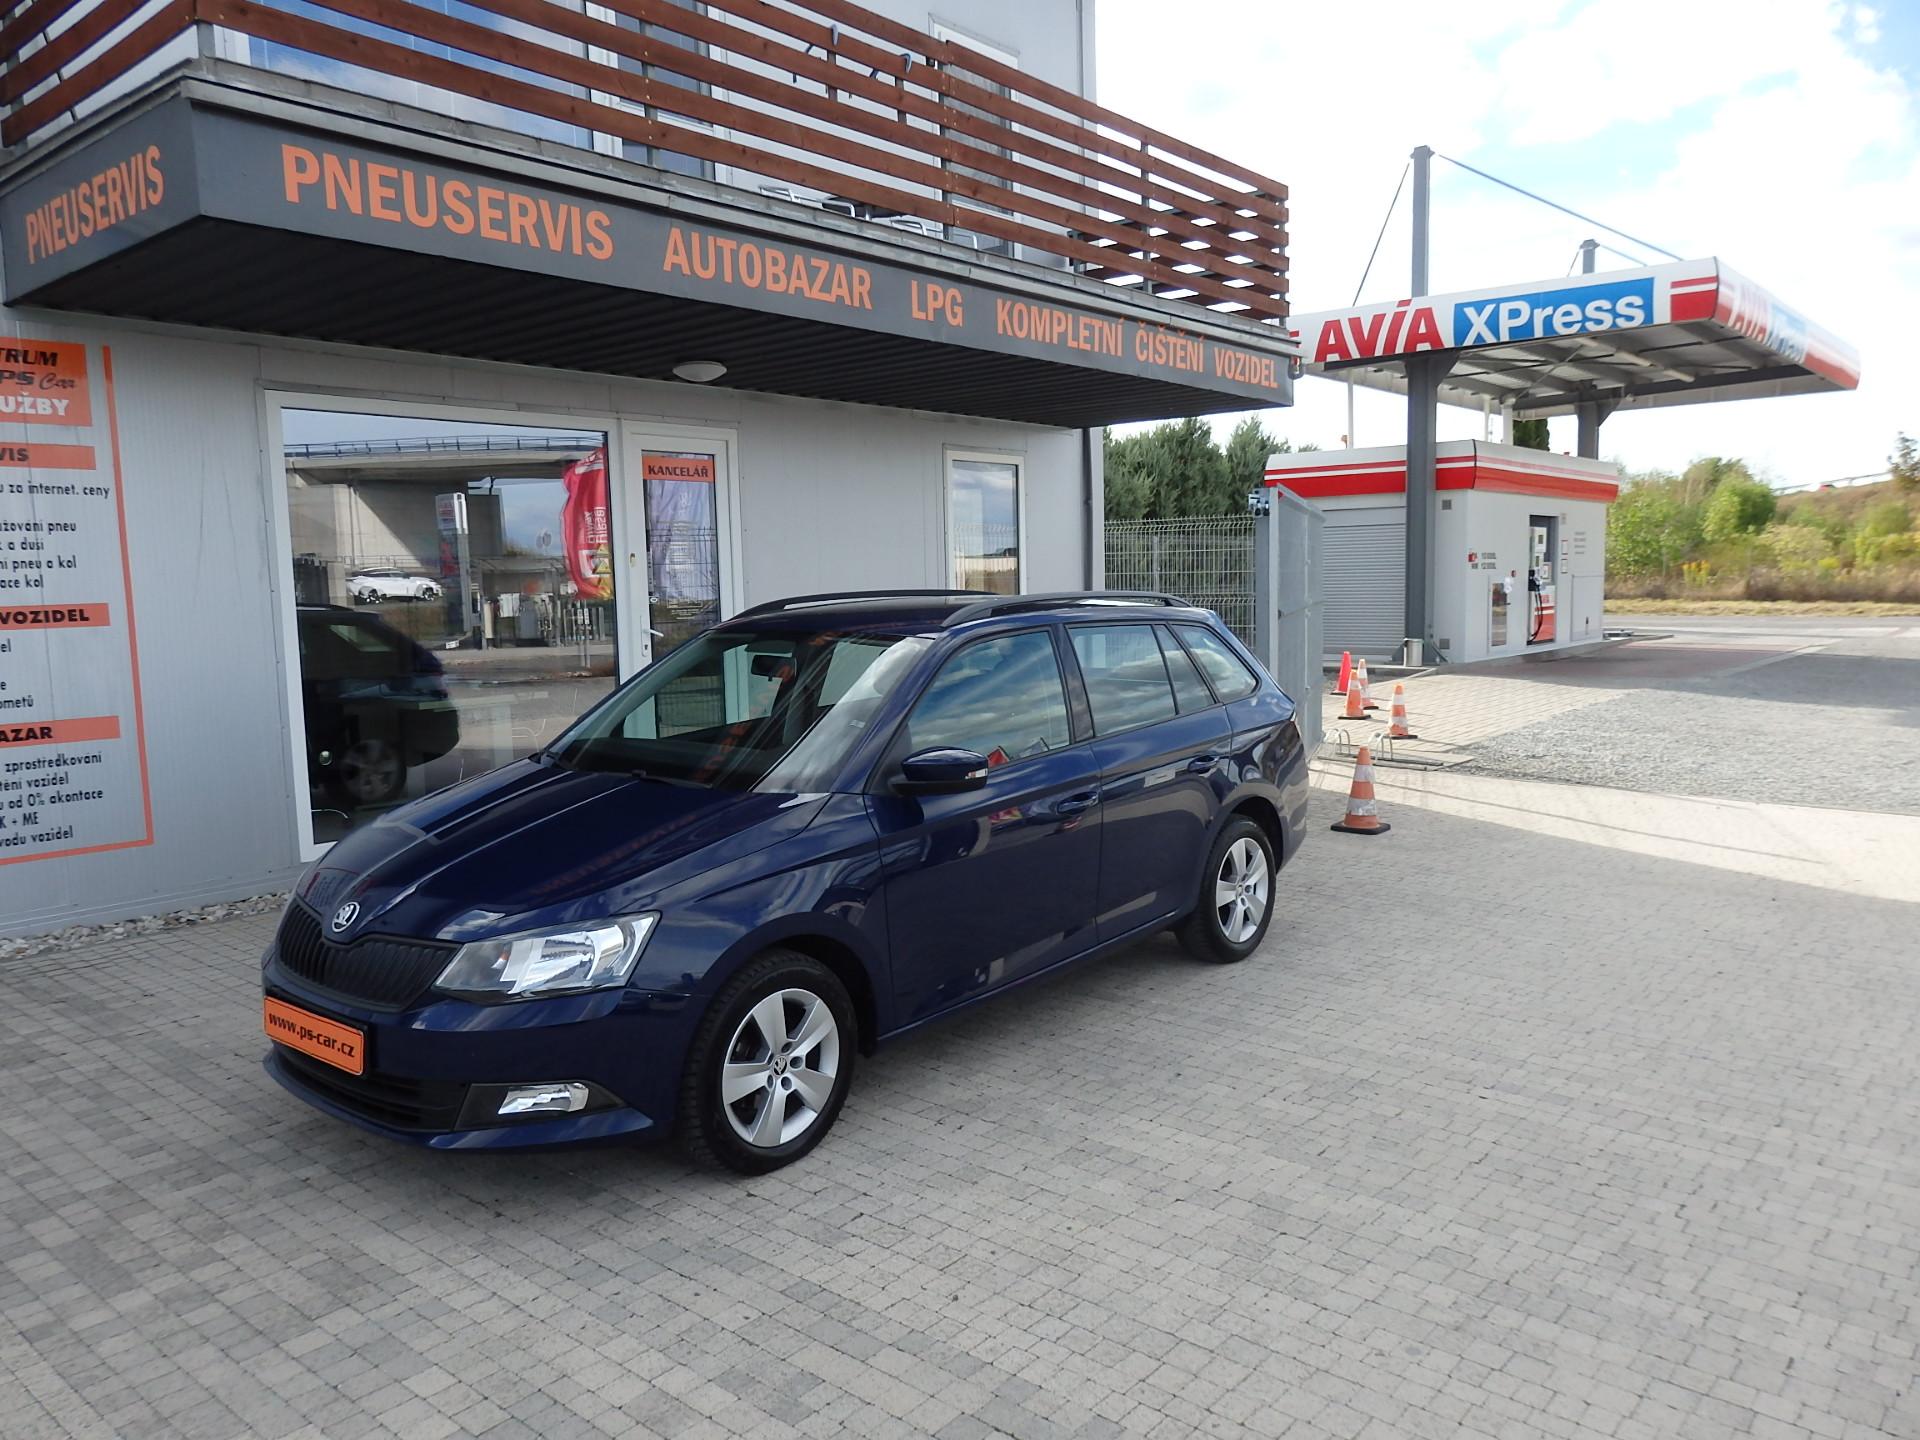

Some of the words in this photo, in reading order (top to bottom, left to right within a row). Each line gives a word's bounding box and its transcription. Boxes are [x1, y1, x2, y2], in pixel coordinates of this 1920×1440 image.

[25, 144, 165, 265] PNEUSERVIS
[281, 144, 615, 261] PNEUSERVIS
[663, 227, 873, 310] AUTOBAZAR
[911, 279, 964, 328] LPG
[996, 298, 1126, 357] KOMPLETNÍ
[1135, 320, 1204, 373] ČIŠTĚNÍ
[1214, 346, 1279, 388] VOZIDEL
[1462, 295, 1645, 347] XPress
[0, 347, 58, 367] RUM
[648, 465, 709, 478] KANCELÁŘ
[28, 480, 79, 495] internet.
[83, 486, 110, 499] ceny
[48, 522, 77, 535] pneu
[12, 560, 42, 573] pneu
[57, 554, 77, 569] kol
[24, 573, 44, 588] kol
[26, 771, 69, 788] vozidel
[8, 794, 23, 809] od
[49, 789, 103, 804] akontace
[30, 825, 74, 842] vozidel
[269, 1013, 355, 1058] www.ps-car.cz
